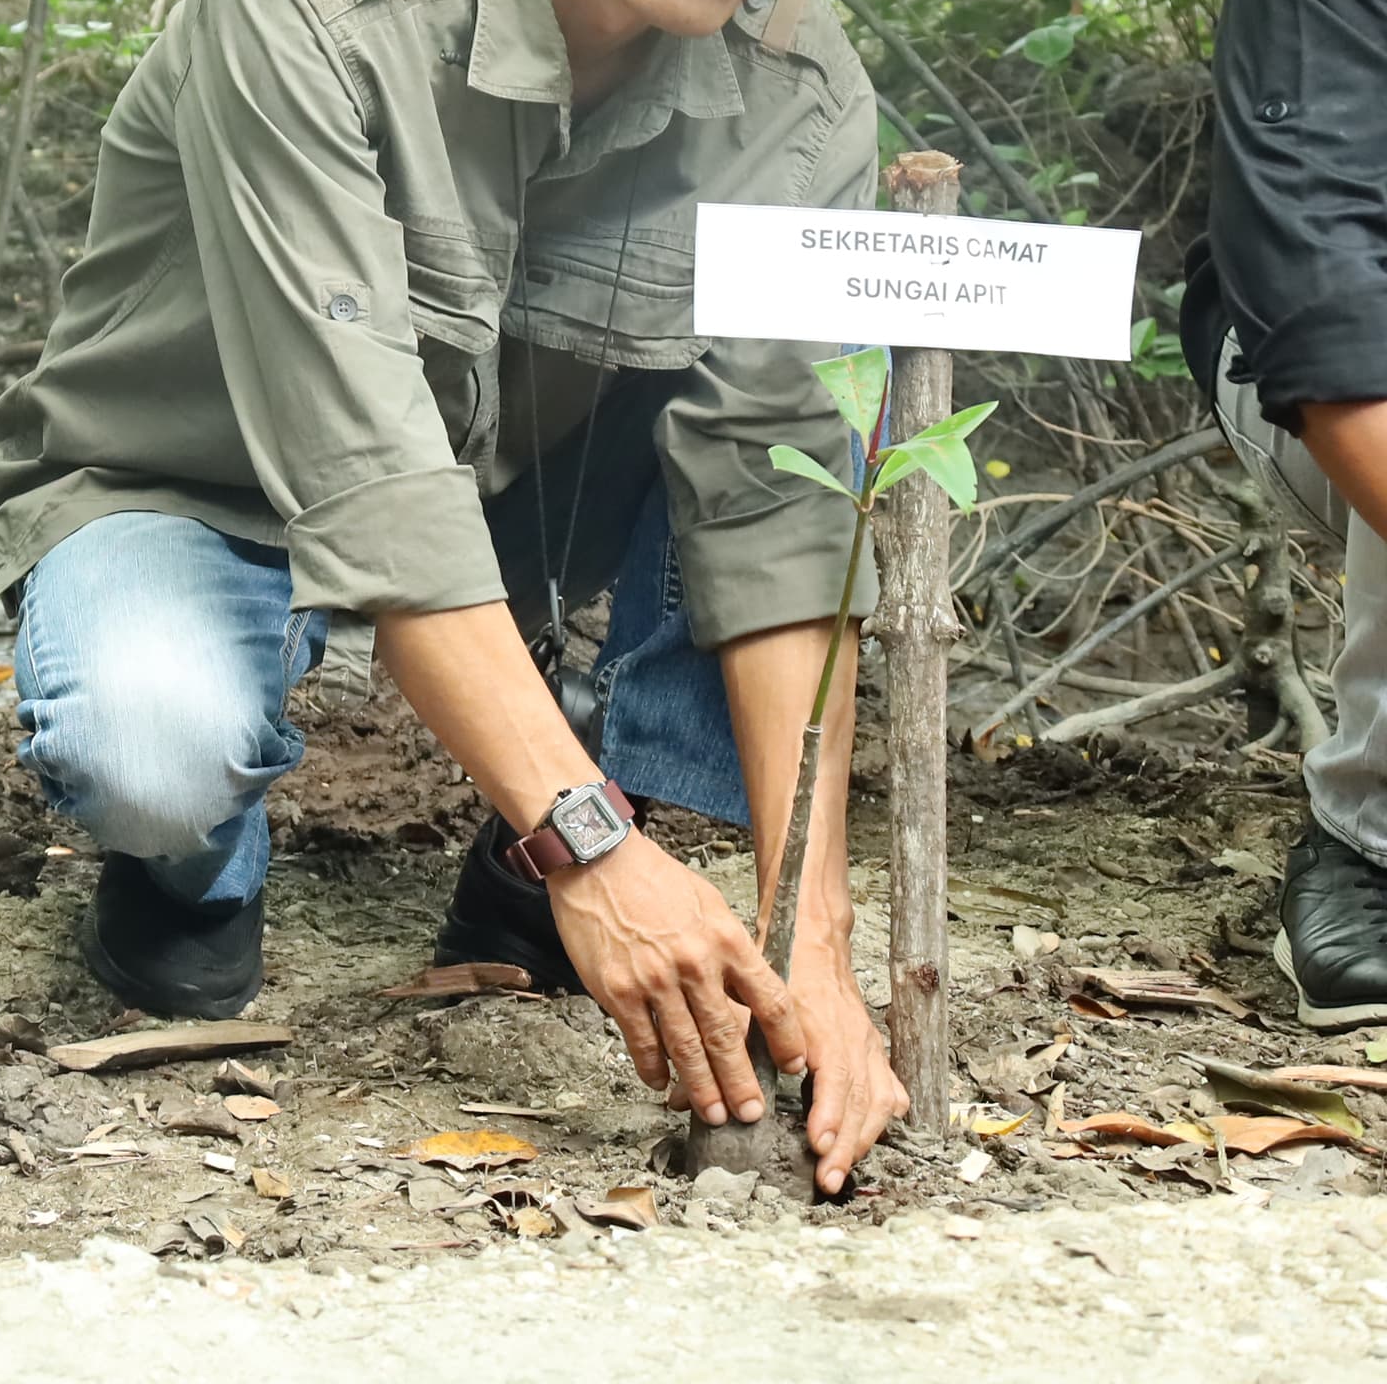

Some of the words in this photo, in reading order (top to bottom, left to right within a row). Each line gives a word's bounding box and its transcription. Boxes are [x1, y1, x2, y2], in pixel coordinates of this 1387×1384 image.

[801, 228, 960, 257] SEKRETARIS
[966, 238, 1049, 264] CAMAT
[846, 276, 948, 303] SUNGAI
[954, 283, 1008, 305] APIT
